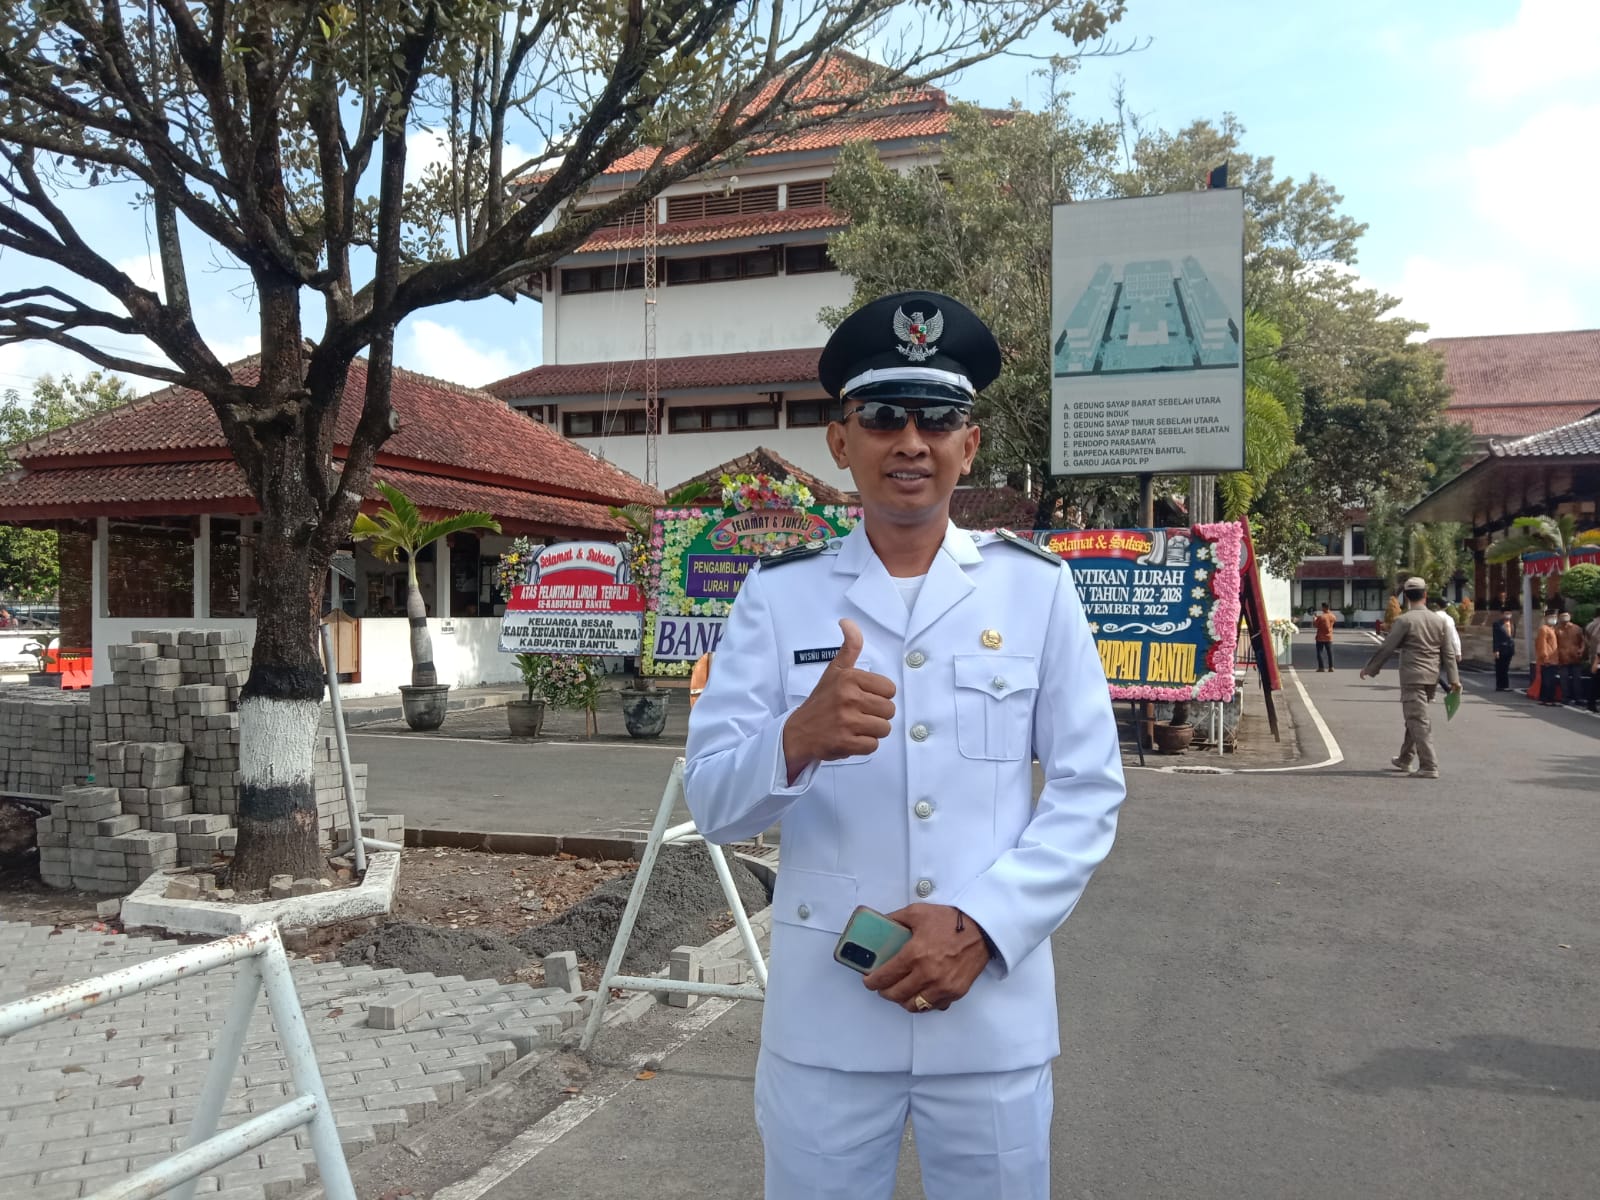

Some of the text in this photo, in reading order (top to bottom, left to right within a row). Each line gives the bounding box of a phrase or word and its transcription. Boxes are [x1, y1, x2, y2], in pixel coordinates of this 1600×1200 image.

[1073, 401, 1105, 410] GEDUNG
[1106, 400, 1130, 409] SAYAP
[1131, 399, 1156, 407] BARAT
[1158, 398, 1194, 406] SEBELAH
[1196, 396, 1221, 404] UTARA
[1073, 411, 1105, 419] GEDUNG
[1106, 410, 1130, 418] INDUK
[1073, 421, 1105, 429] GEDUNG
[1106, 419, 1130, 428] SAYAP
[1131, 418, 1156, 426] TIMUR
[1156, 417, 1192, 426] SEBELAH
[1193, 416, 1220, 424] UTARA
[1073, 430, 1105, 439] GEDUNG
[1106, 429, 1130, 438] SAYAP
[1131, 428, 1156, 436] BARAT
[1158, 427, 1194, 435] SEBELAH
[1195, 425, 1231, 434] SELATAN
[1073, 439, 1109, 448] PENDOPO
[1110, 438, 1157, 446] PARASAMYA
[1073, 449, 1108, 457] BAPPEDA
[1109, 448, 1154, 456] KABUPATEN
[1155, 446, 1186, 455] BANTUL
[1073, 458, 1100, 467] GARDU
[1101, 458, 1121, 466] JAGA
[1122, 457, 1138, 465] POL
[1139, 457, 1149, 465] PP
[772, 516, 778, 528] &
[1048, 534, 1153, 554] Selamat & Sukses
[540, 548, 616, 568] Selamat & Sukses
[693, 561, 749, 574] PENGAMBILAN
[1073, 569, 1186, 586] NTIKAN LURAH
[520, 585, 630, 600] ATAS PELANTIKAN LURAH TERPILIH
[703, 579, 744, 593] LURAH M
[1088, 586, 1130, 602] TAHUN
[538, 599, 611, 609] SE-KABUPATEN BANTUL
[1083, 603, 1169, 616] VEMBER 2022
[528, 617, 613, 629] KELUARGA BESAR
[503, 626, 530, 638] KAUR
[520, 638, 619, 650] KABUPATEN BANTUL
[799, 651, 820, 662] WISNU
[1146, 641, 1197, 684] BANTUL
